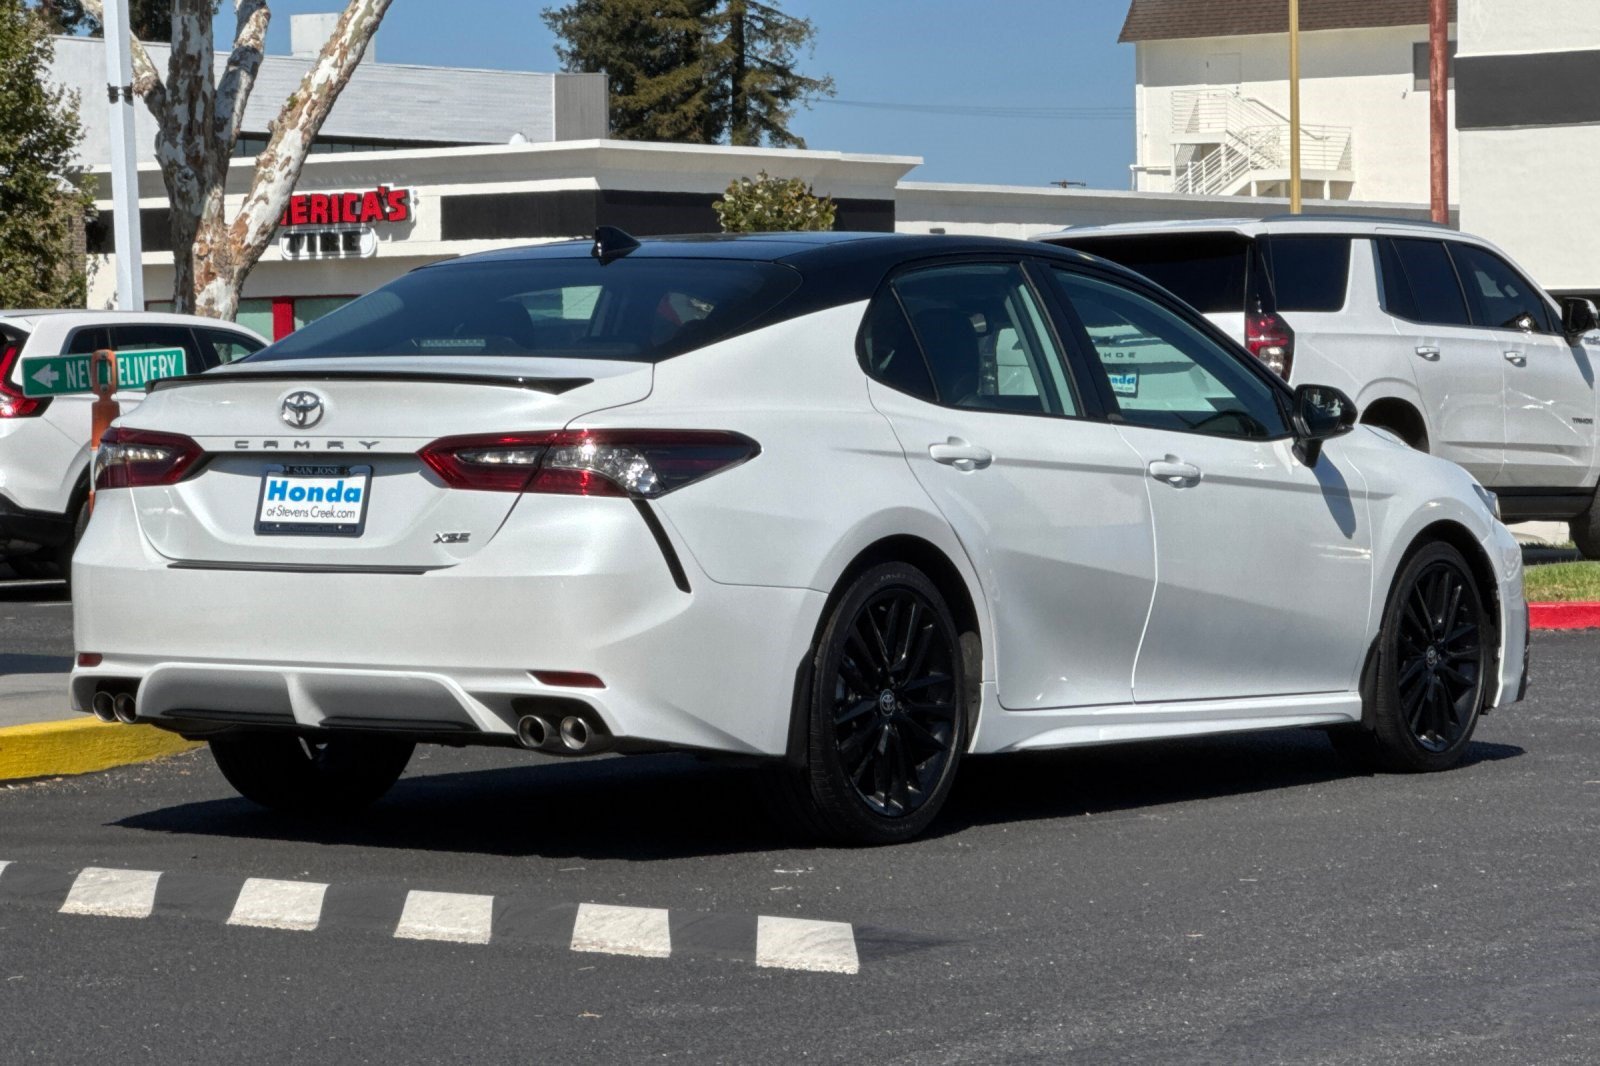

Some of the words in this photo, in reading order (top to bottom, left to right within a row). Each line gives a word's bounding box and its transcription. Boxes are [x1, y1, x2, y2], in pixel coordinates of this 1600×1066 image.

[280, 186, 408, 226] ERICA'S
[1103, 351, 1137, 359] HOE
[1111, 374, 1136, 385] nda
[234, 440, 380, 450] CAMRY
[293, 466, 312, 475] SAN
[267, 480, 362, 503] Honda
[266, 507, 276, 517] of
[433, 533, 471, 543] XSE
